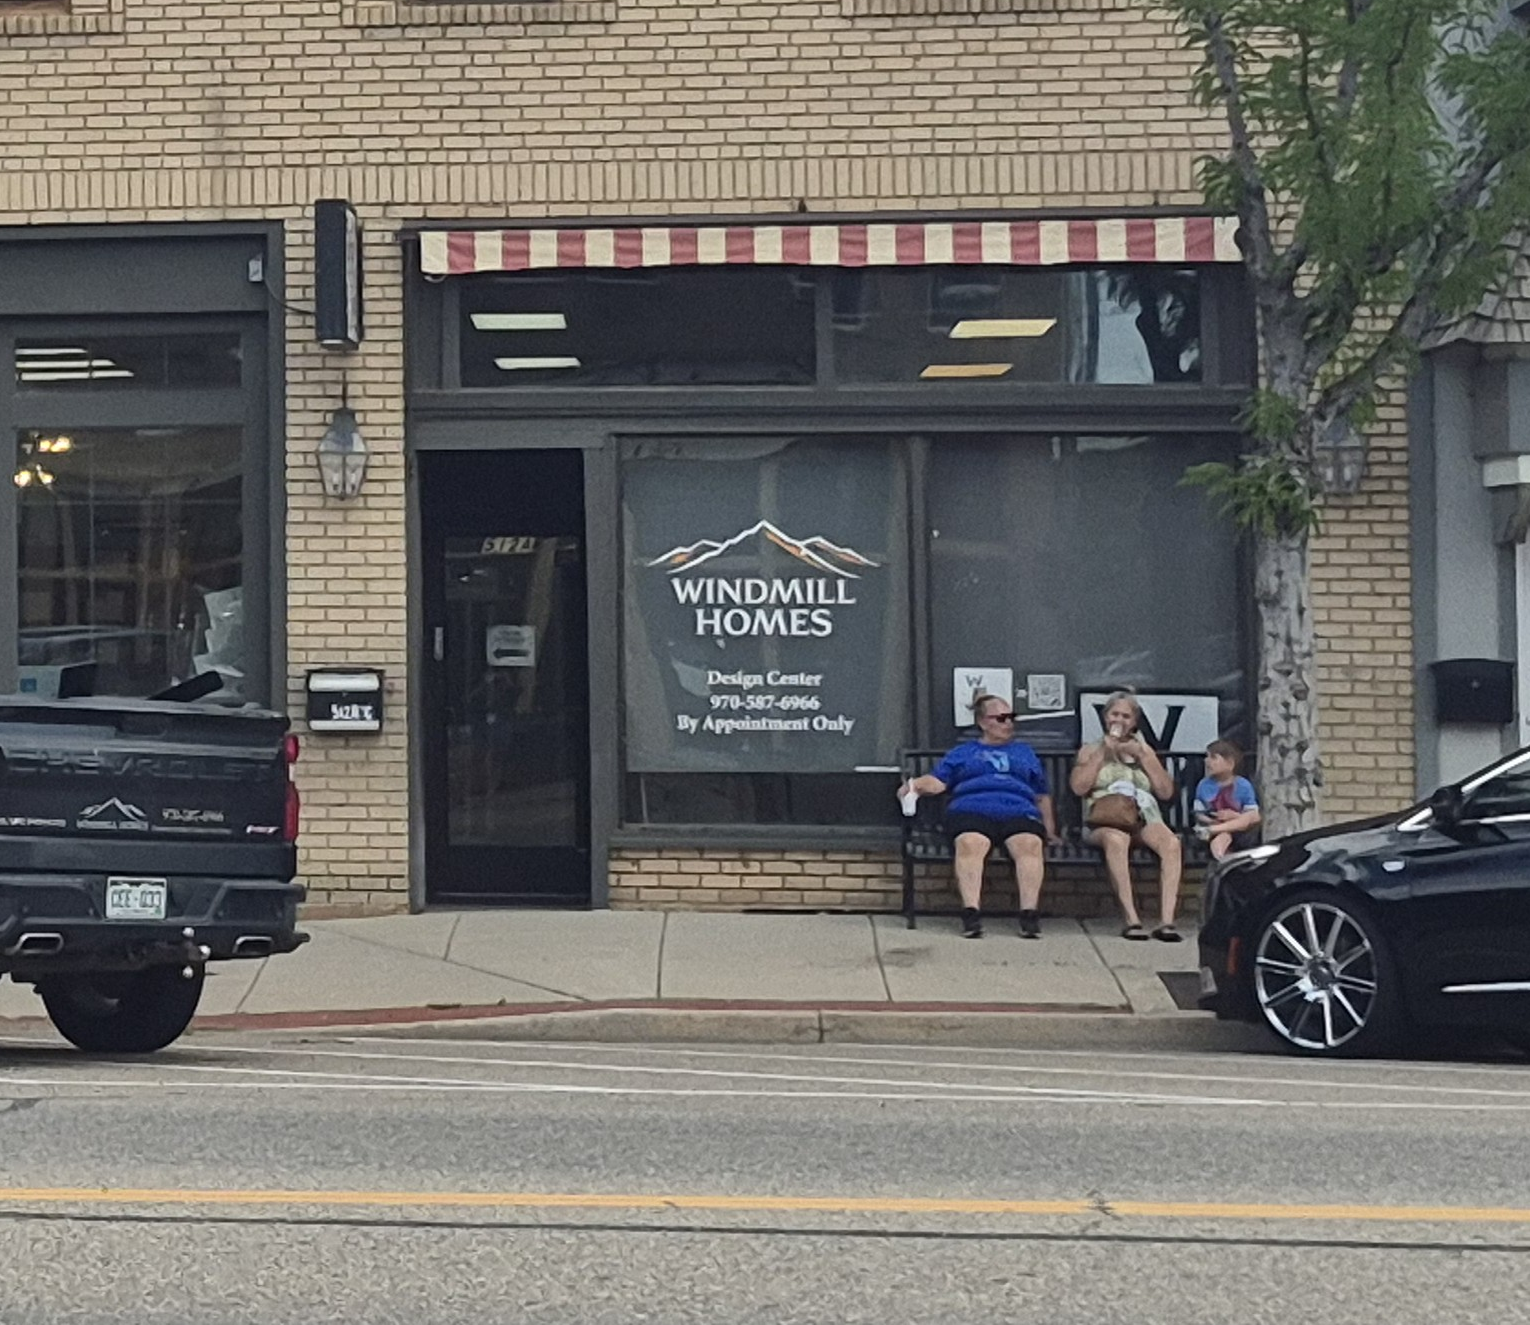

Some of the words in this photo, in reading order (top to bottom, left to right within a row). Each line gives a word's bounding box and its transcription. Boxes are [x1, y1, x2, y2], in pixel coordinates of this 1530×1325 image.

[671, 577, 857, 605] WINDMILL
[695, 608, 833, 637] HOMES
[707, 670, 763, 690] Design
[767, 670, 823, 687] Center
[709, 694, 820, 710] 970-587-6966
[677, 714, 699, 734] By
[702, 715, 809, 734] Appointment
[812, 714, 856, 735] Only
